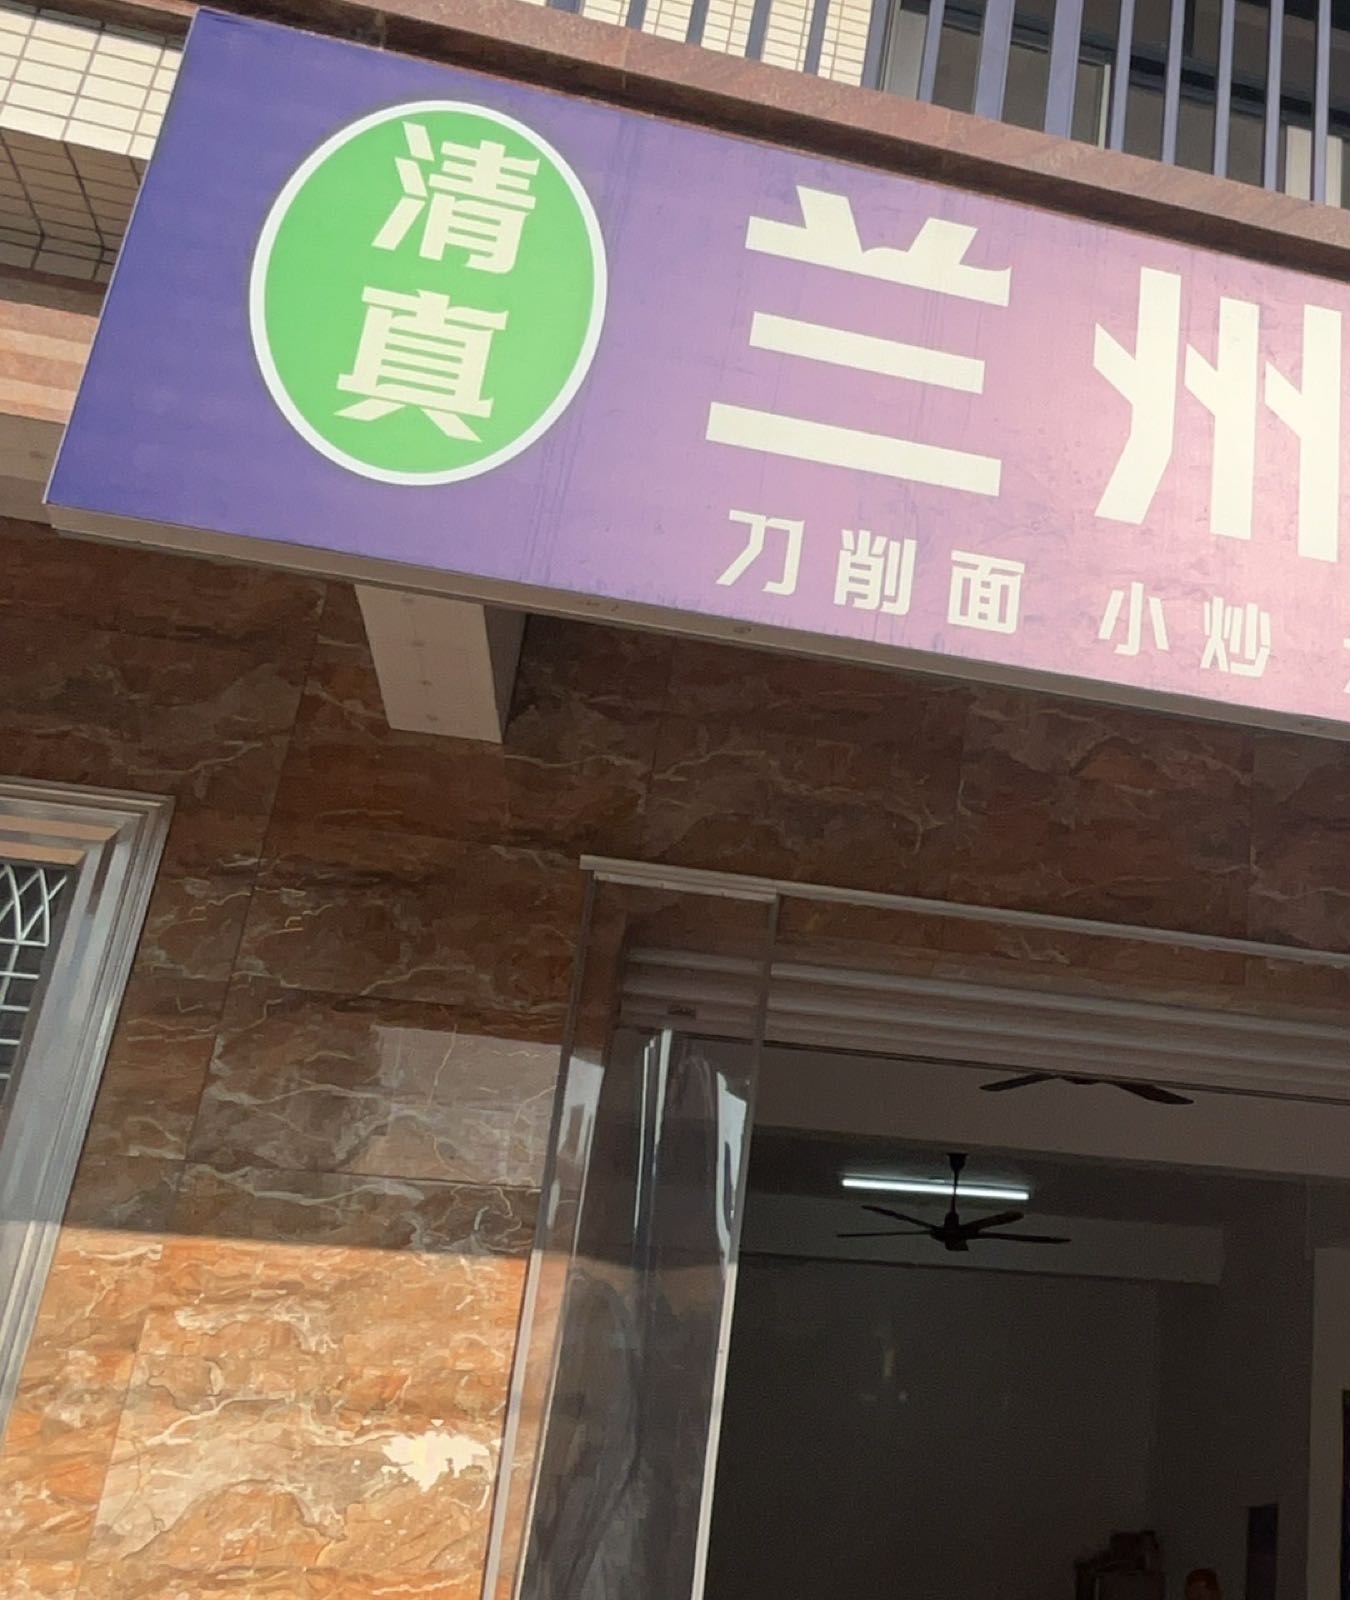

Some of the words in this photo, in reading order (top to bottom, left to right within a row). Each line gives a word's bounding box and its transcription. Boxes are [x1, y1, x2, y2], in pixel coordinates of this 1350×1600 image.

[334, 122, 540, 442] 清真
[717, 510, 1026, 635] 刀削面
[1098, 581, 1271, 678] 小炒
